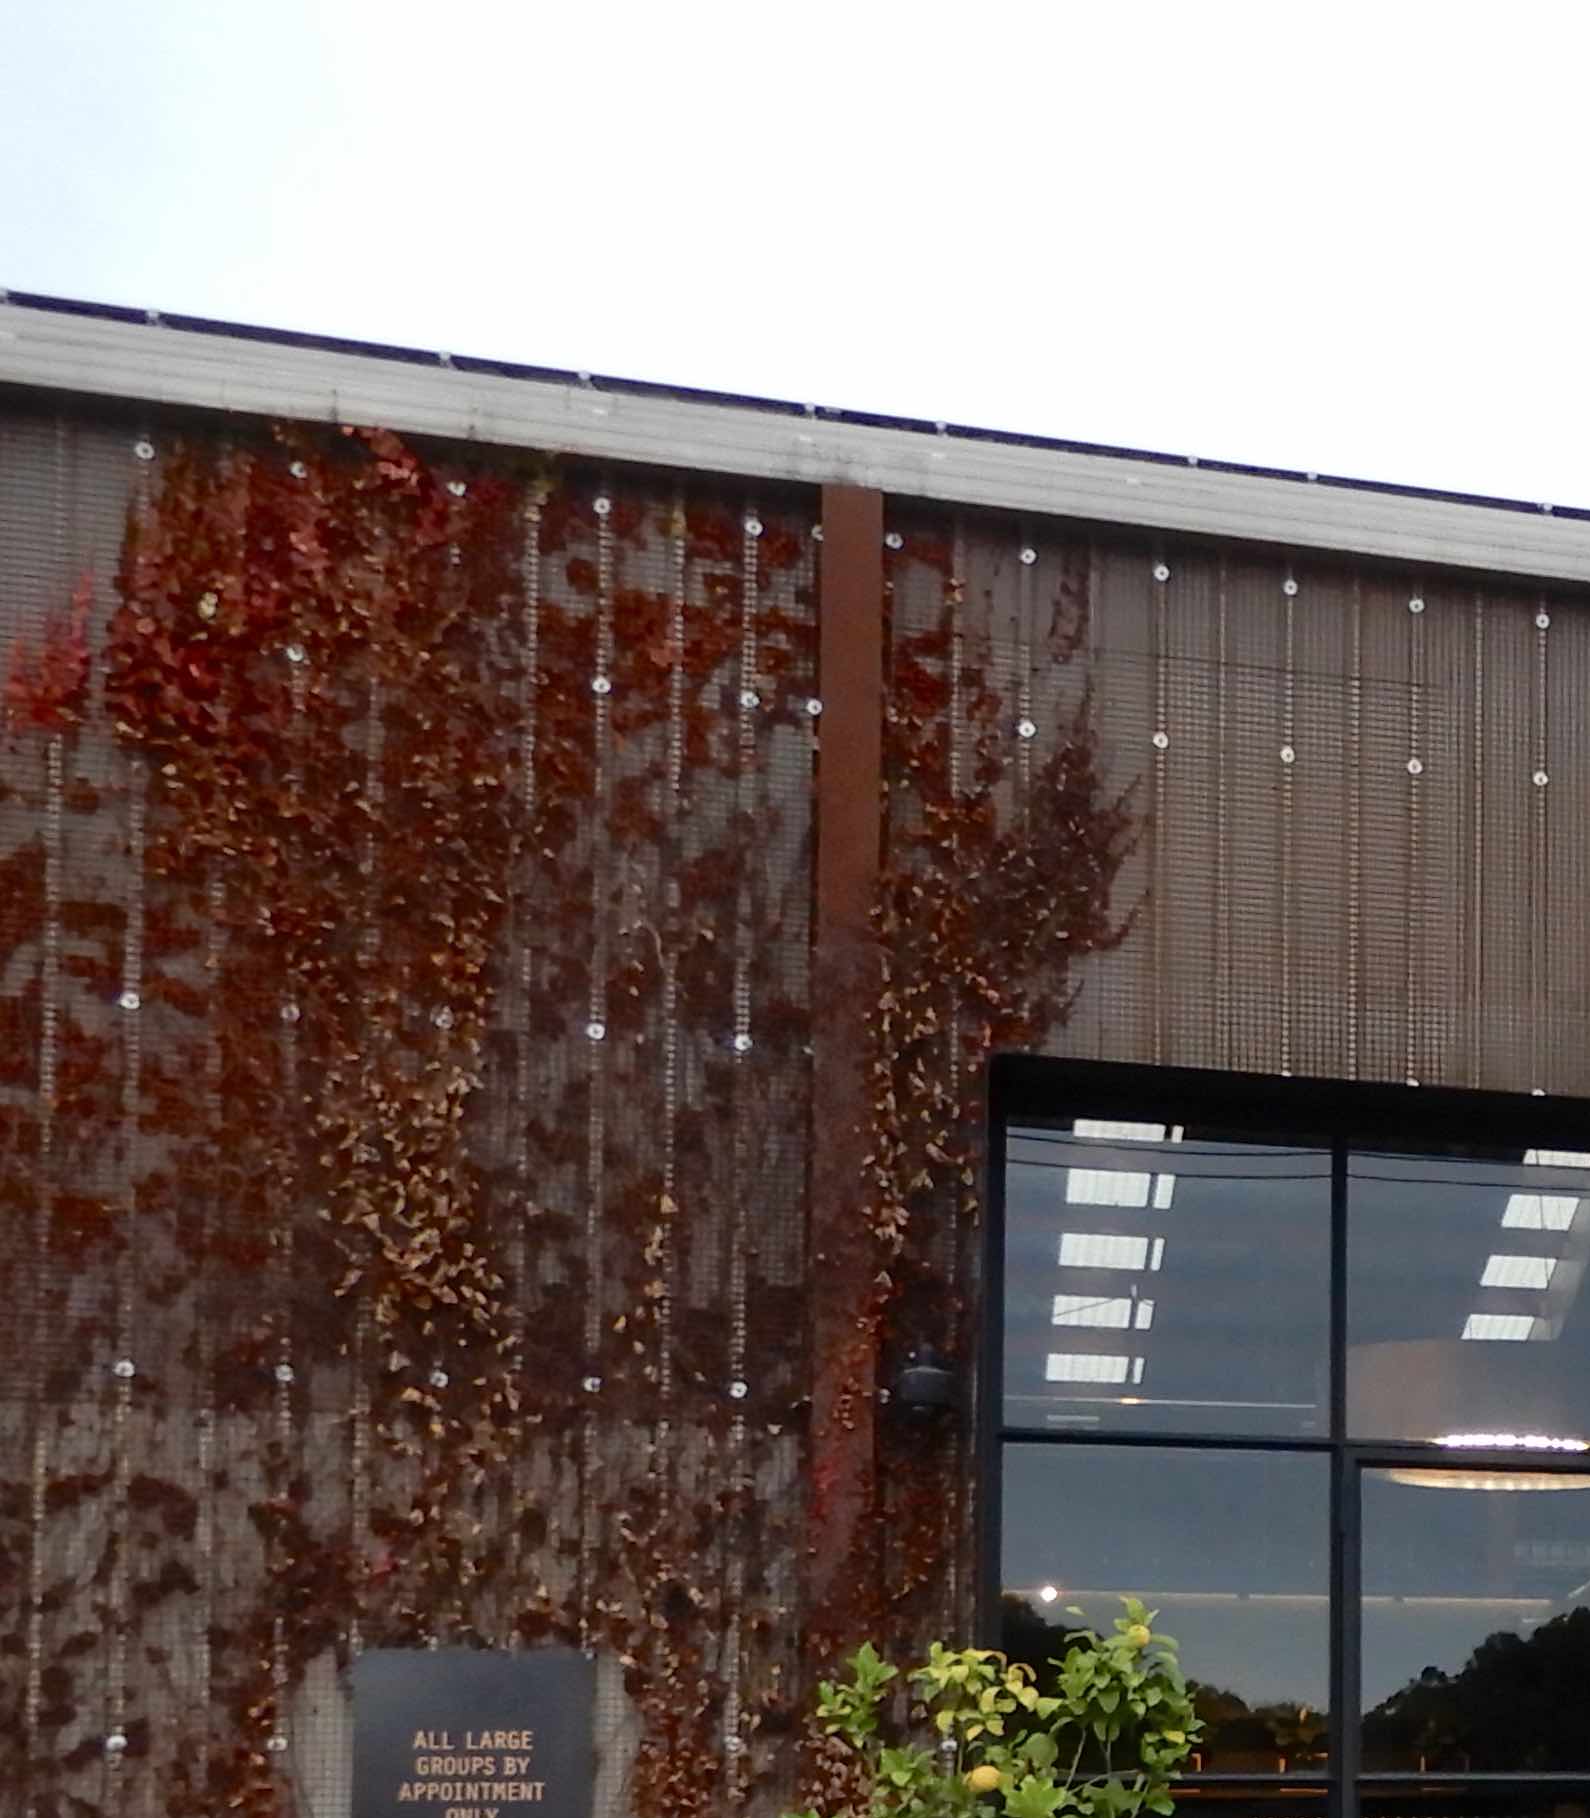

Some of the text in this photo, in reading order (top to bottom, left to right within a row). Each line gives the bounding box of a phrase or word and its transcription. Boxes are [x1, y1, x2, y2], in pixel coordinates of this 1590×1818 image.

[412, 1730, 534, 1750] ALL LARGE
[416, 1756, 531, 1776] GROUPS BY
[398, 1781, 545, 1802] APPOINTMENT
